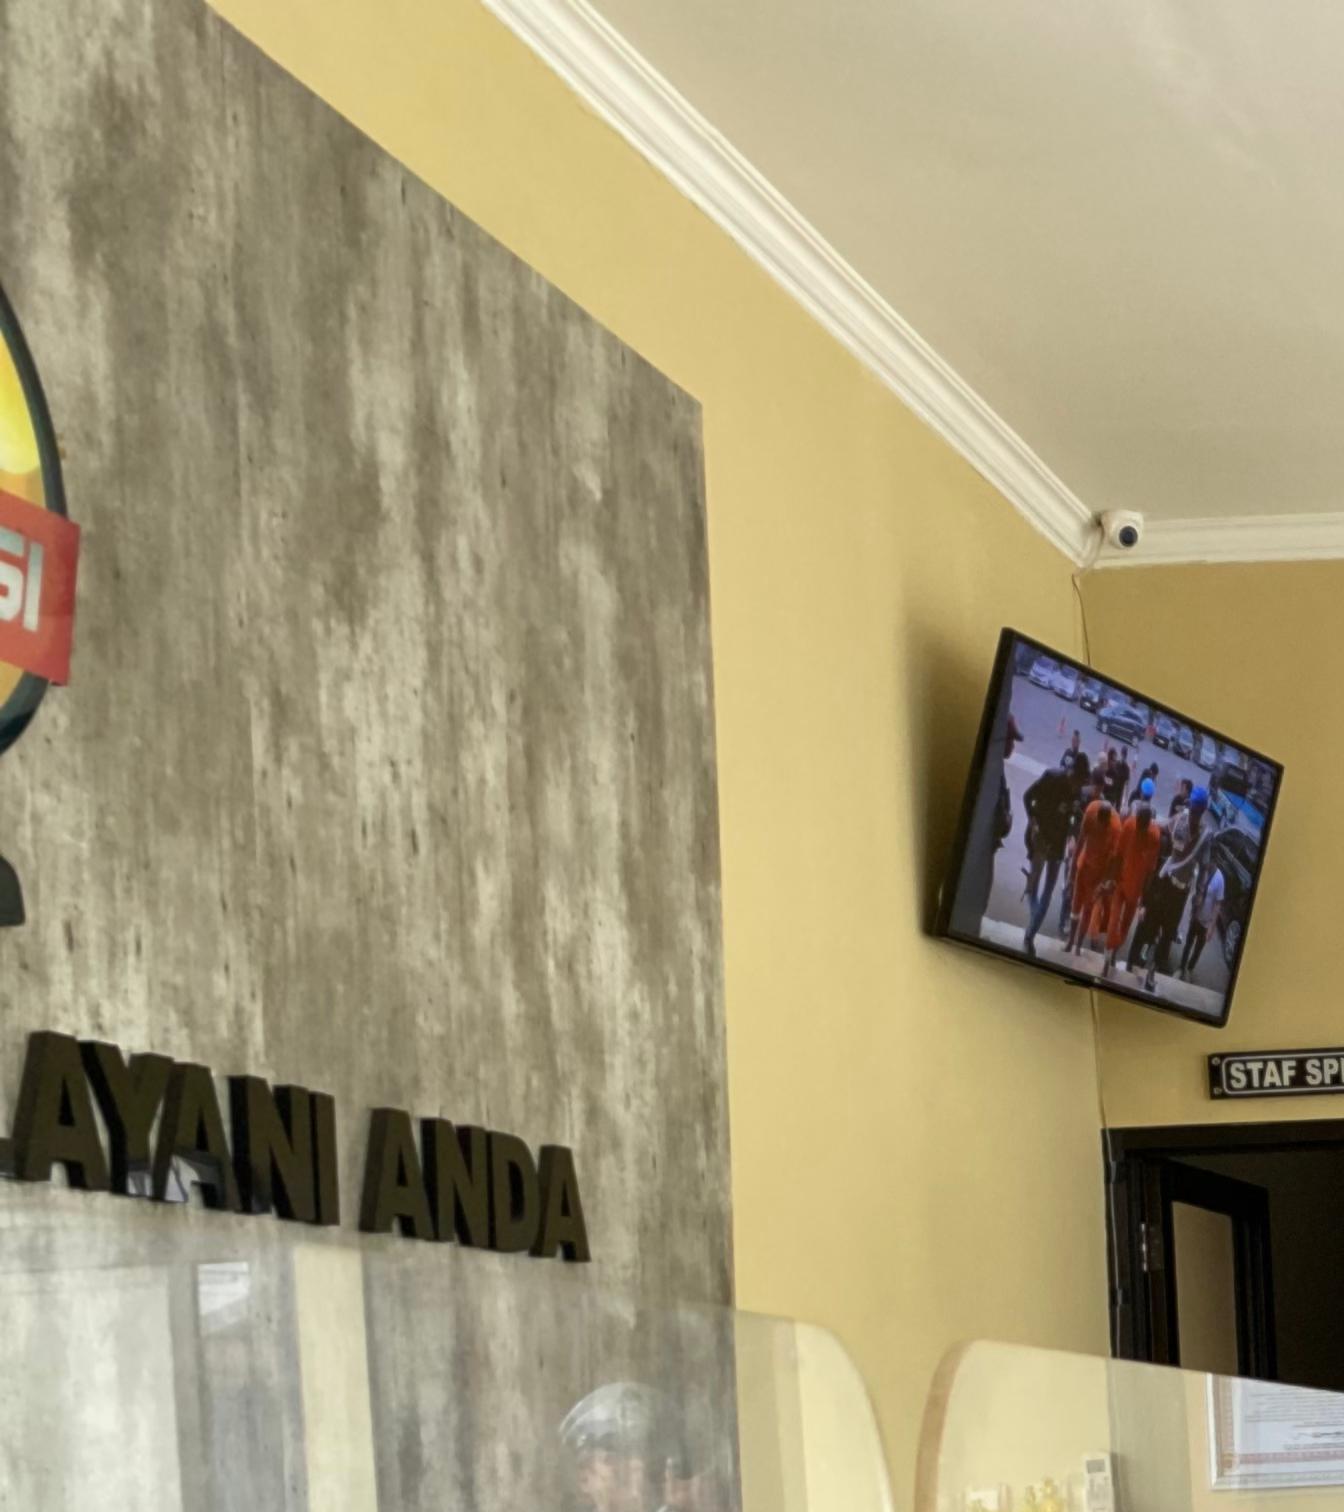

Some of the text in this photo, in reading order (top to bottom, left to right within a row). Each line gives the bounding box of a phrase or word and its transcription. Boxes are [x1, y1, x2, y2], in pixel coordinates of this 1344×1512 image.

[1229, 1060, 1298, 1089] STAF
[0, 1030, 591, 1262] AYANI ANDA
